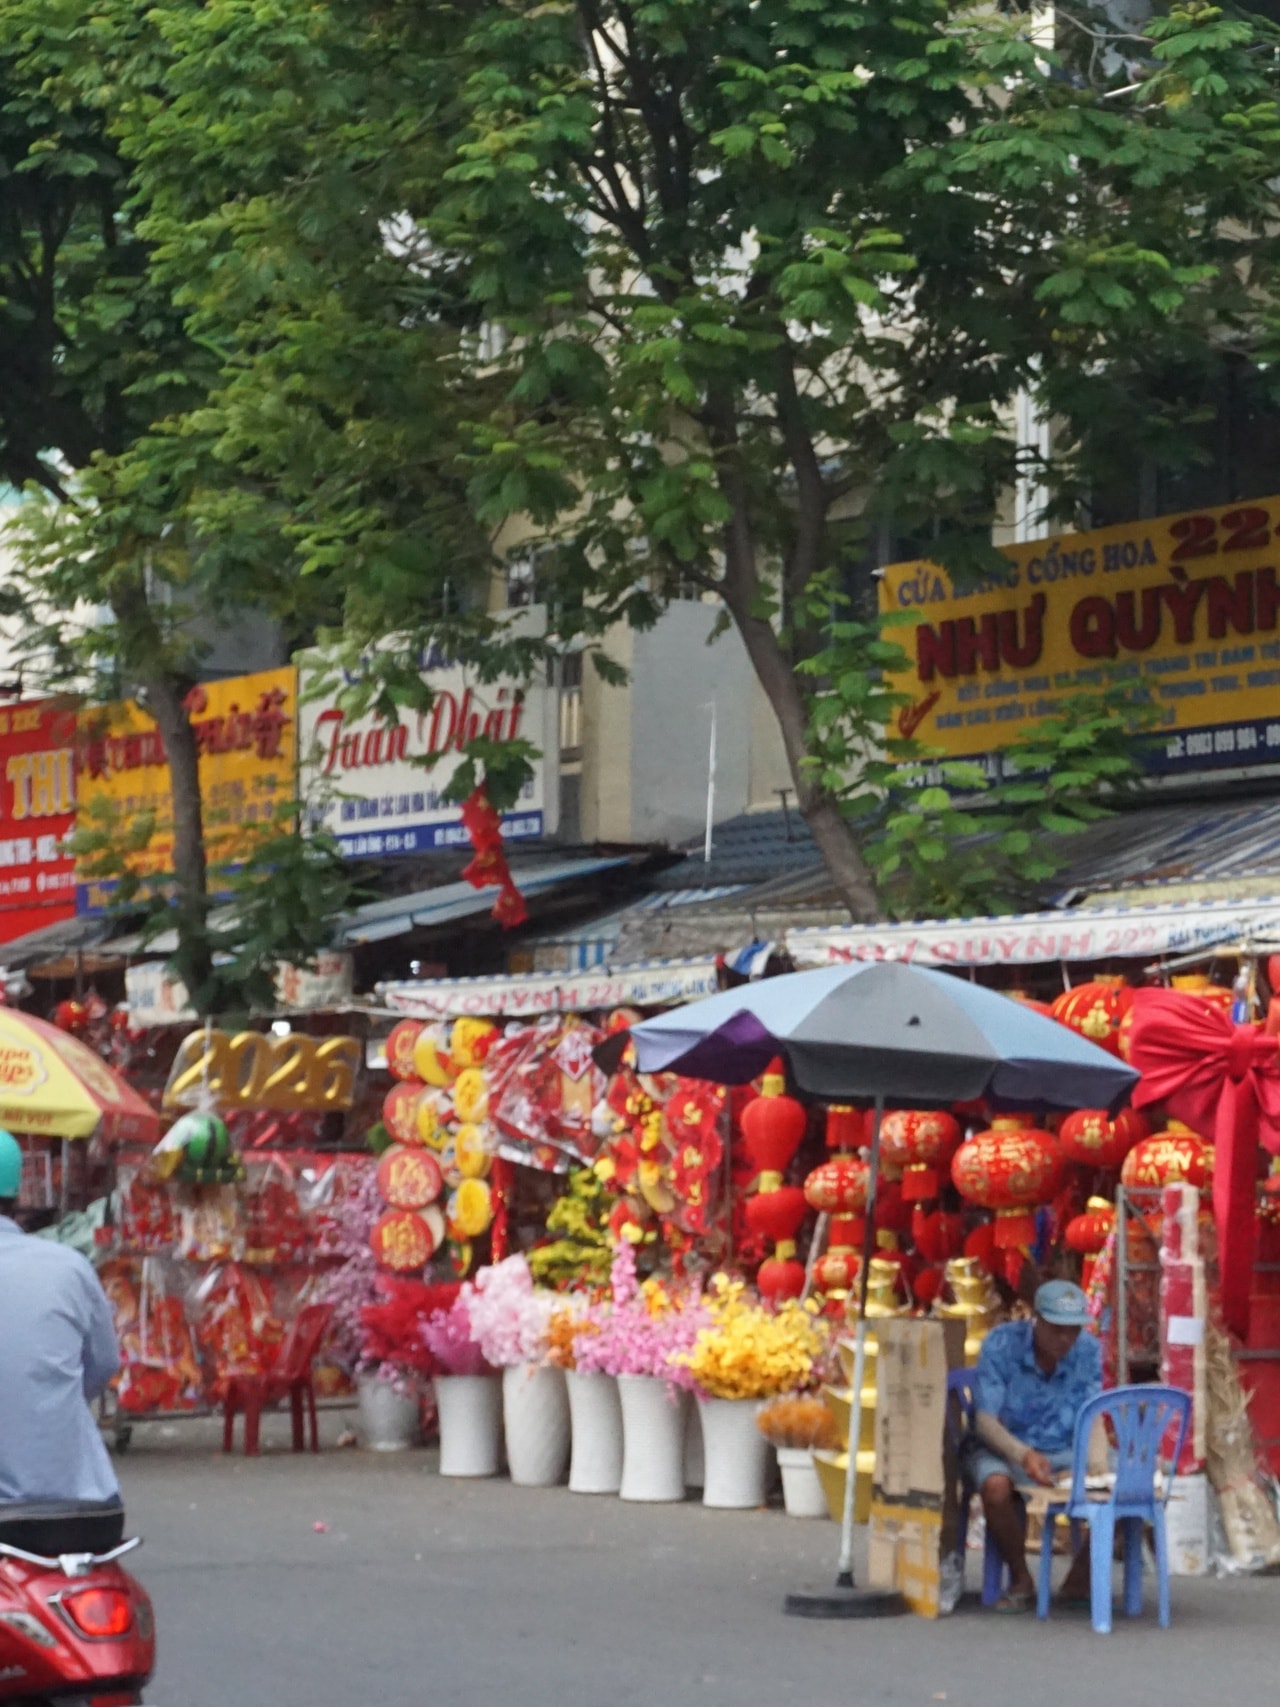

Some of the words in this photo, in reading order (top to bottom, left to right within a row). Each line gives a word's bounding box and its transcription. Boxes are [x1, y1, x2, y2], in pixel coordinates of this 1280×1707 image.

[1103, 538, 1157, 573] HOA
[917, 591, 1047, 682] NHƯ
[163, 1028, 360, 1110] 2026
